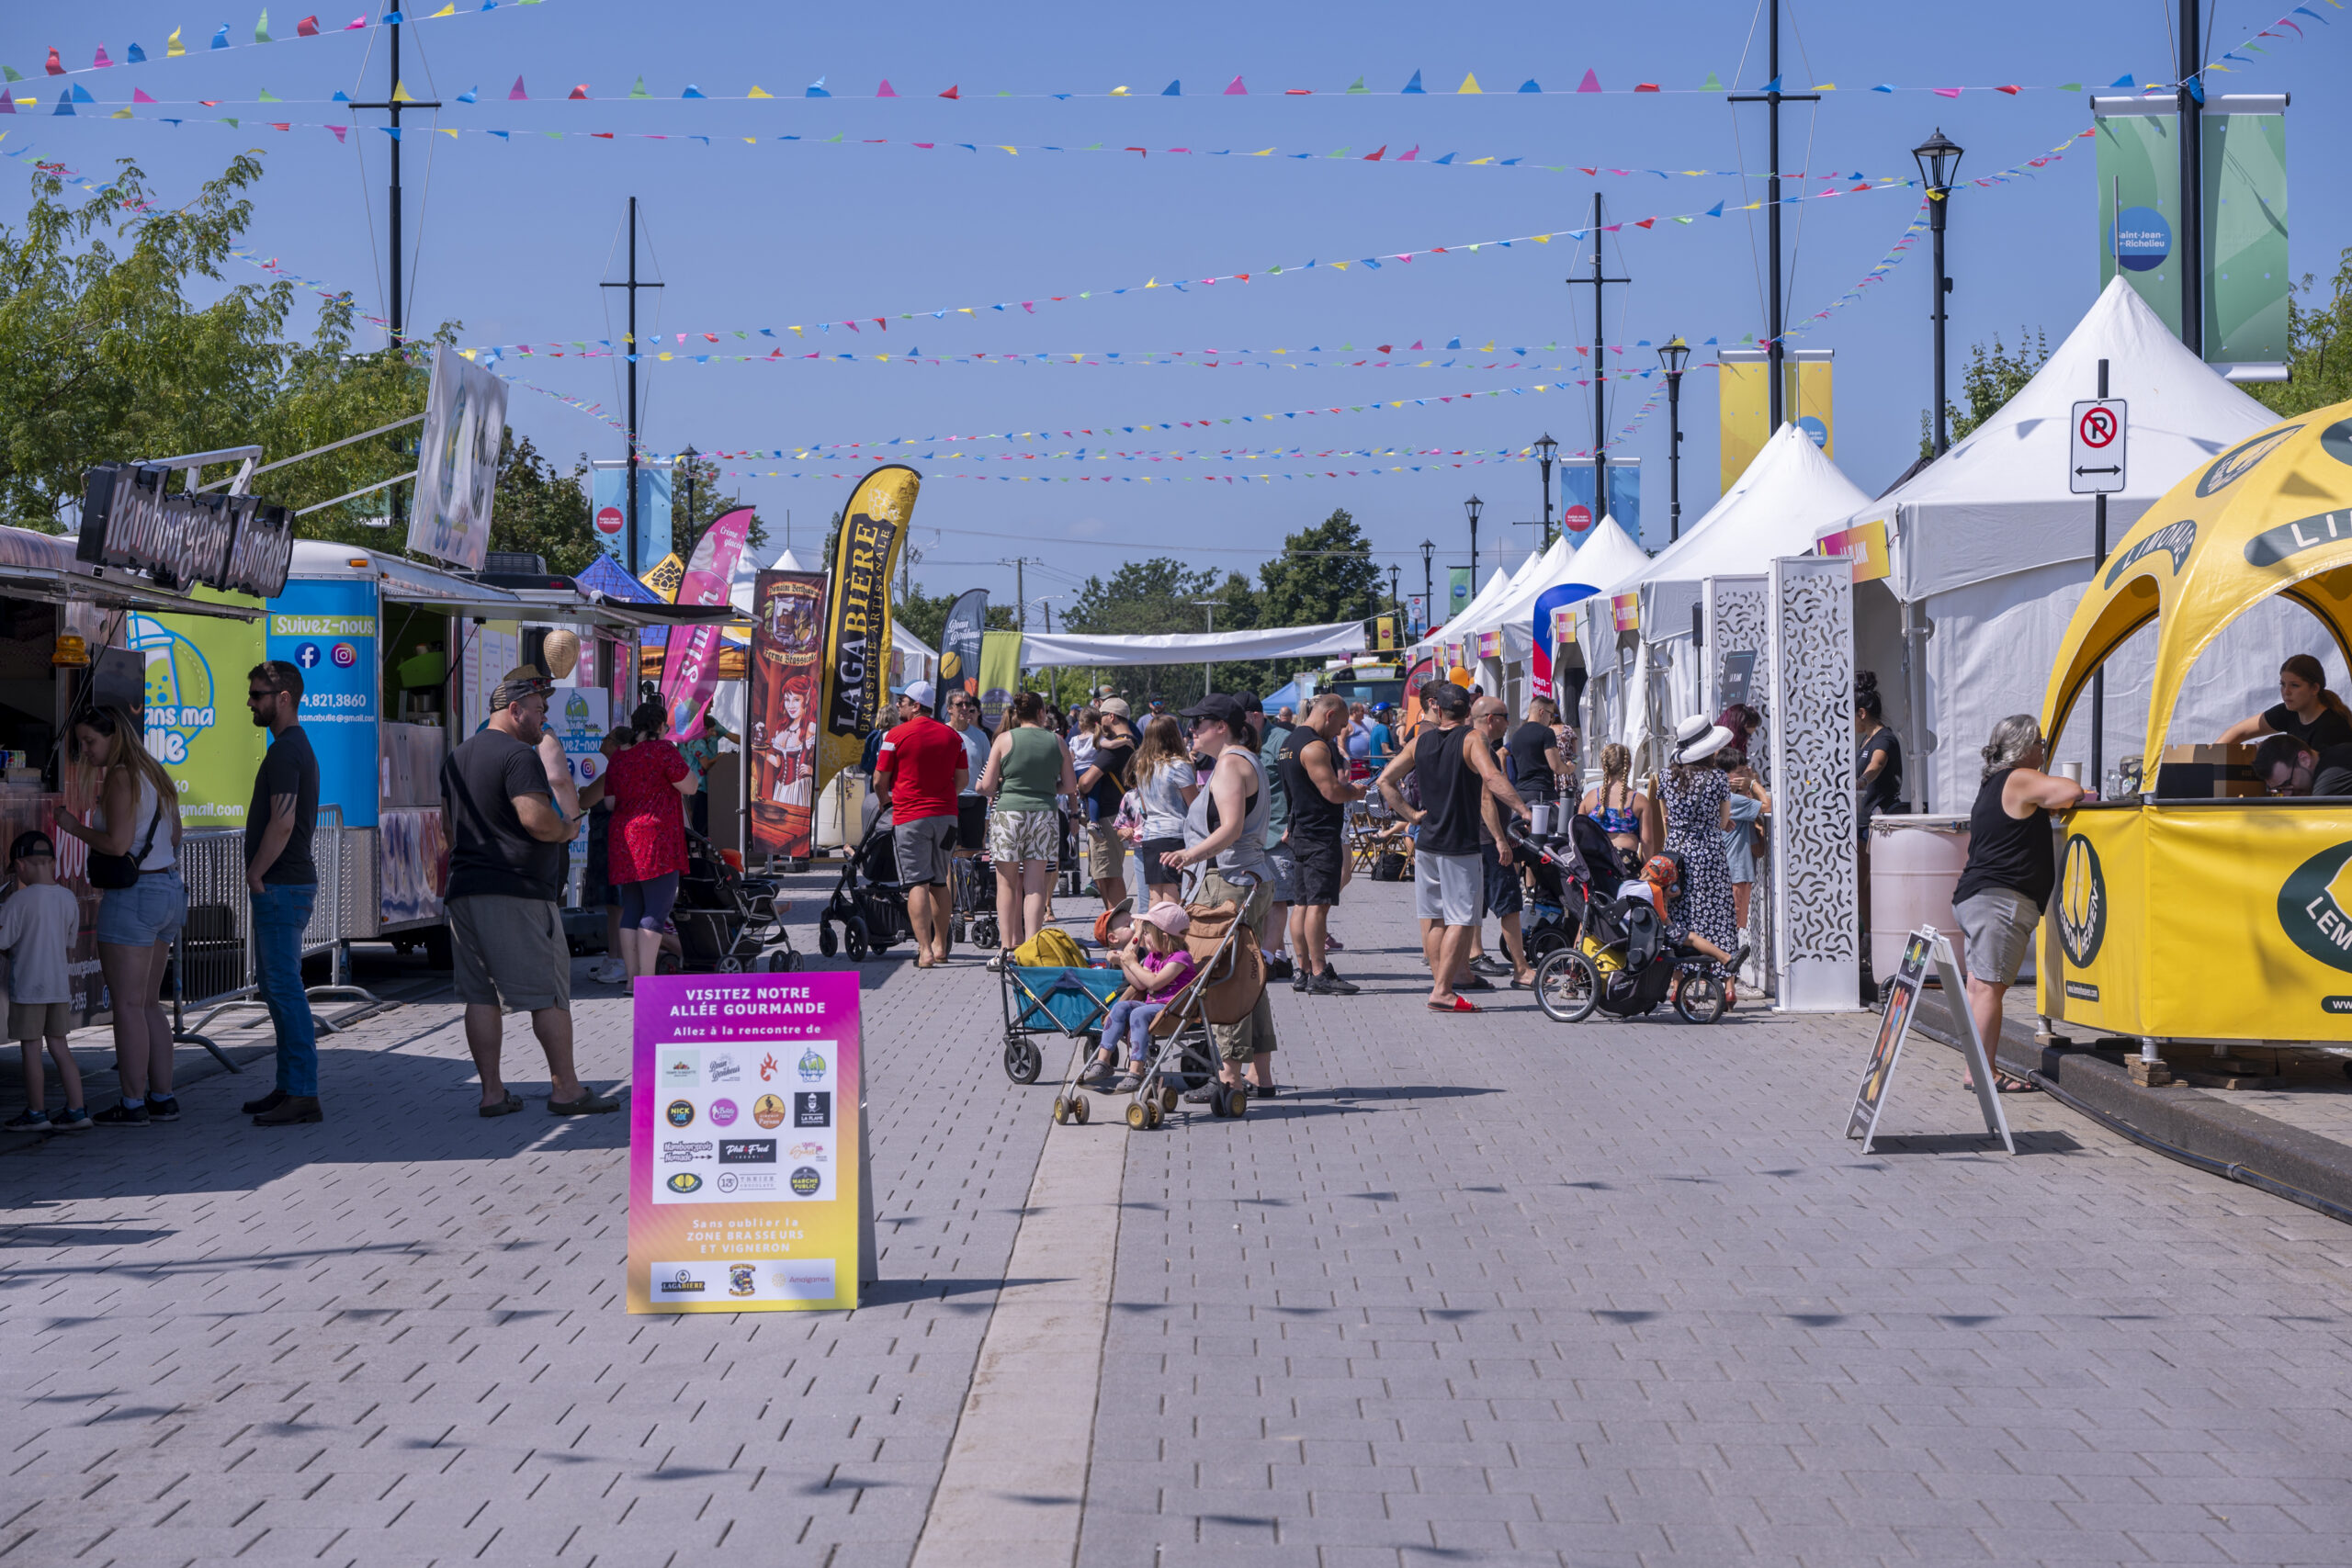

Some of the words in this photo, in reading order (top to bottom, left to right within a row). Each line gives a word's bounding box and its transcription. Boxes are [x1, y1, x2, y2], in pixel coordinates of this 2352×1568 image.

[105, 478, 232, 581] Hambourgeois
[2291, 511, 2352, 547] LI
[229, 510, 290, 589] Nomade
[2122, 521, 2195, 571] LIMONADE
[868, 530, 890, 634] ARTISANALE
[277, 616, 373, 634] Suivez-nous
[859, 641, 876, 732] BRASSERIE
[144, 707, 176, 726] ans
[181, 707, 214, 726] ma
[298, 713, 375, 723] nsmabulle@gmail.com
[144, 728, 186, 762] lle
[179, 802, 244, 818] gmail.com
[2306, 896, 2352, 951] LEM
[686, 988, 751, 1001] VISITEZ
[757, 987, 810, 999] NOTRE
[670, 1002, 717, 1016] ALLÉE
[724, 1002, 825, 1015] GOURMANDE
[673, 1026, 705, 1037] Allez
[710, 1024, 717, 1036] à
[722, 1025, 734, 1035] la
[739, 1026, 801, 1035] rencontre
[806, 1024, 821, 1034] de
[663, 1141, 713, 1152] Hambourgeois
[726, 1145, 744, 1155] Phil
[748, 1144, 770, 1154] Fred
[664, 1152, 693, 1162] Nomade
[693, 1219, 723, 1229] Sans
[729, 1218, 780, 1228] oublier
[786, 1218, 798, 1227] la
[687, 1231, 721, 1241] ZONE
[727, 1230, 804, 1241] BRASSEURS
[701, 1244, 717, 1254] ET
[722, 1243, 790, 1253] VIGNERON
[789, 1275, 830, 1284] Amalgames
